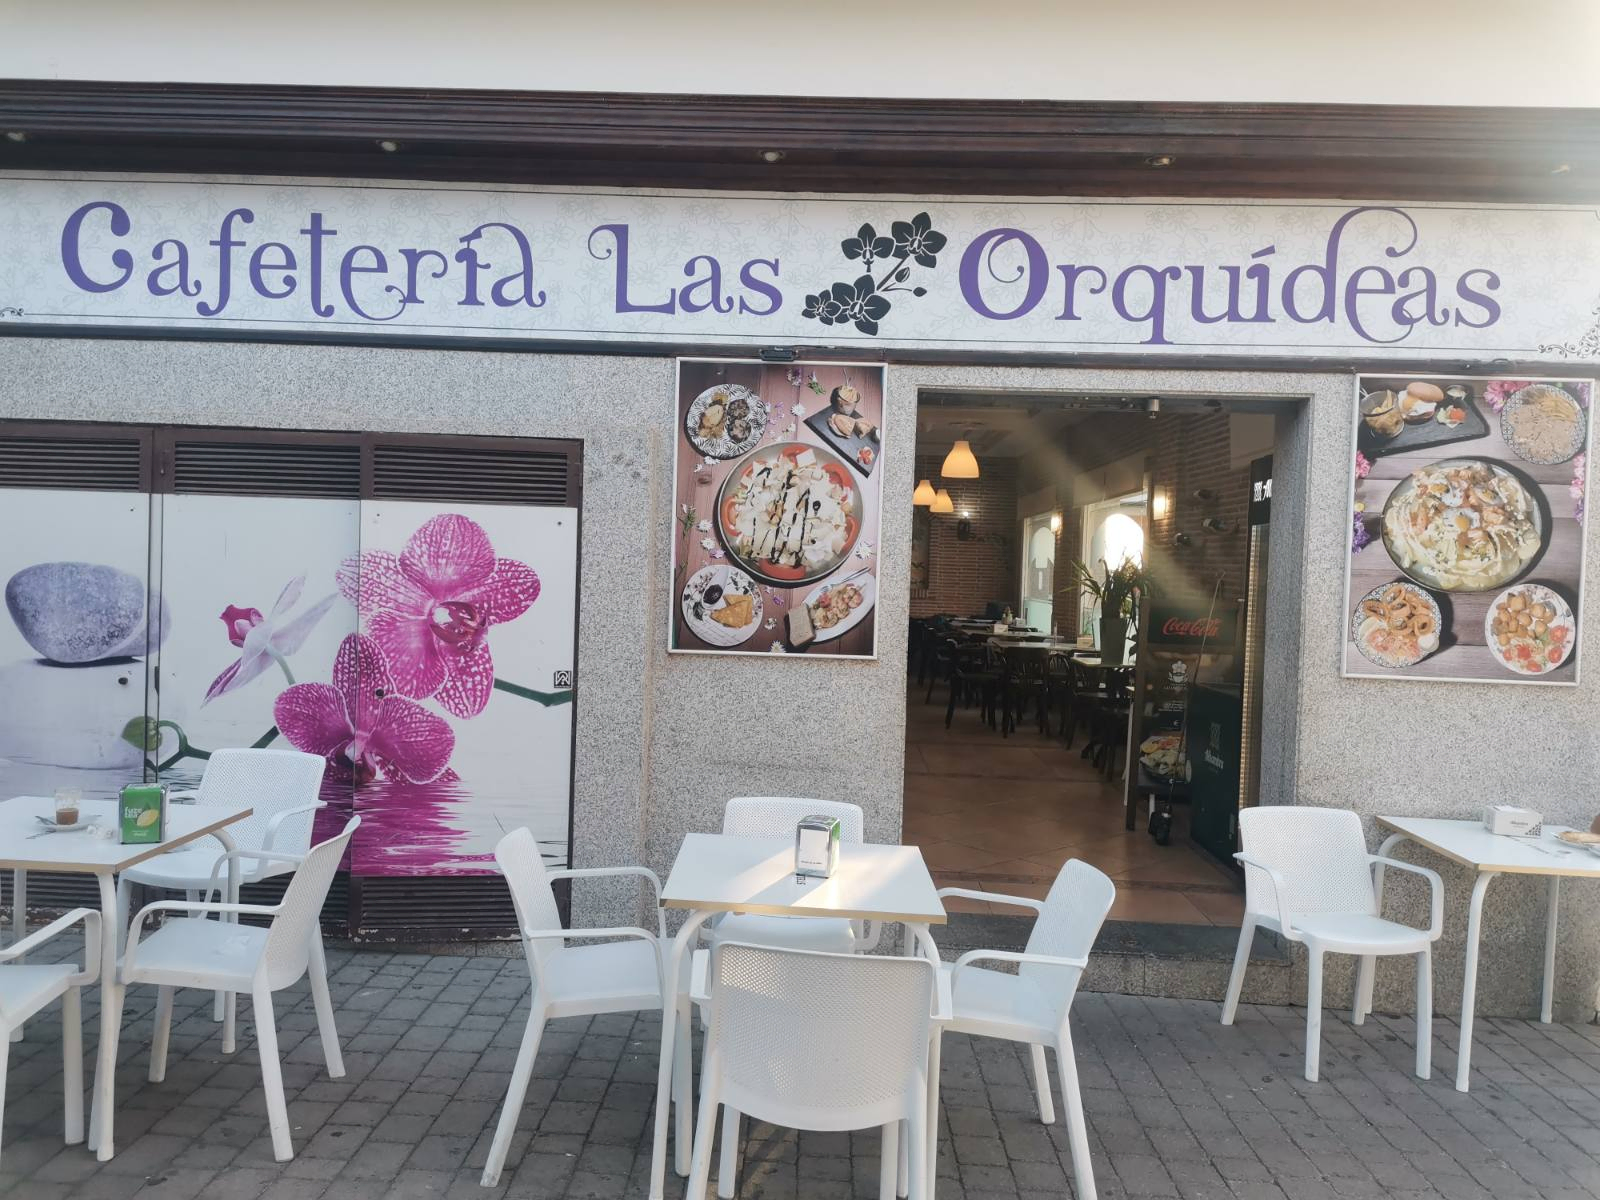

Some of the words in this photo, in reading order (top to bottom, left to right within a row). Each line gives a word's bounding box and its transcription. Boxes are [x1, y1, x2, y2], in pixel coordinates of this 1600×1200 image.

[60, 201, 547, 321] Cafetería
[590, 223, 784, 317] Las
[958, 206, 1501, 345] Orquídeas
